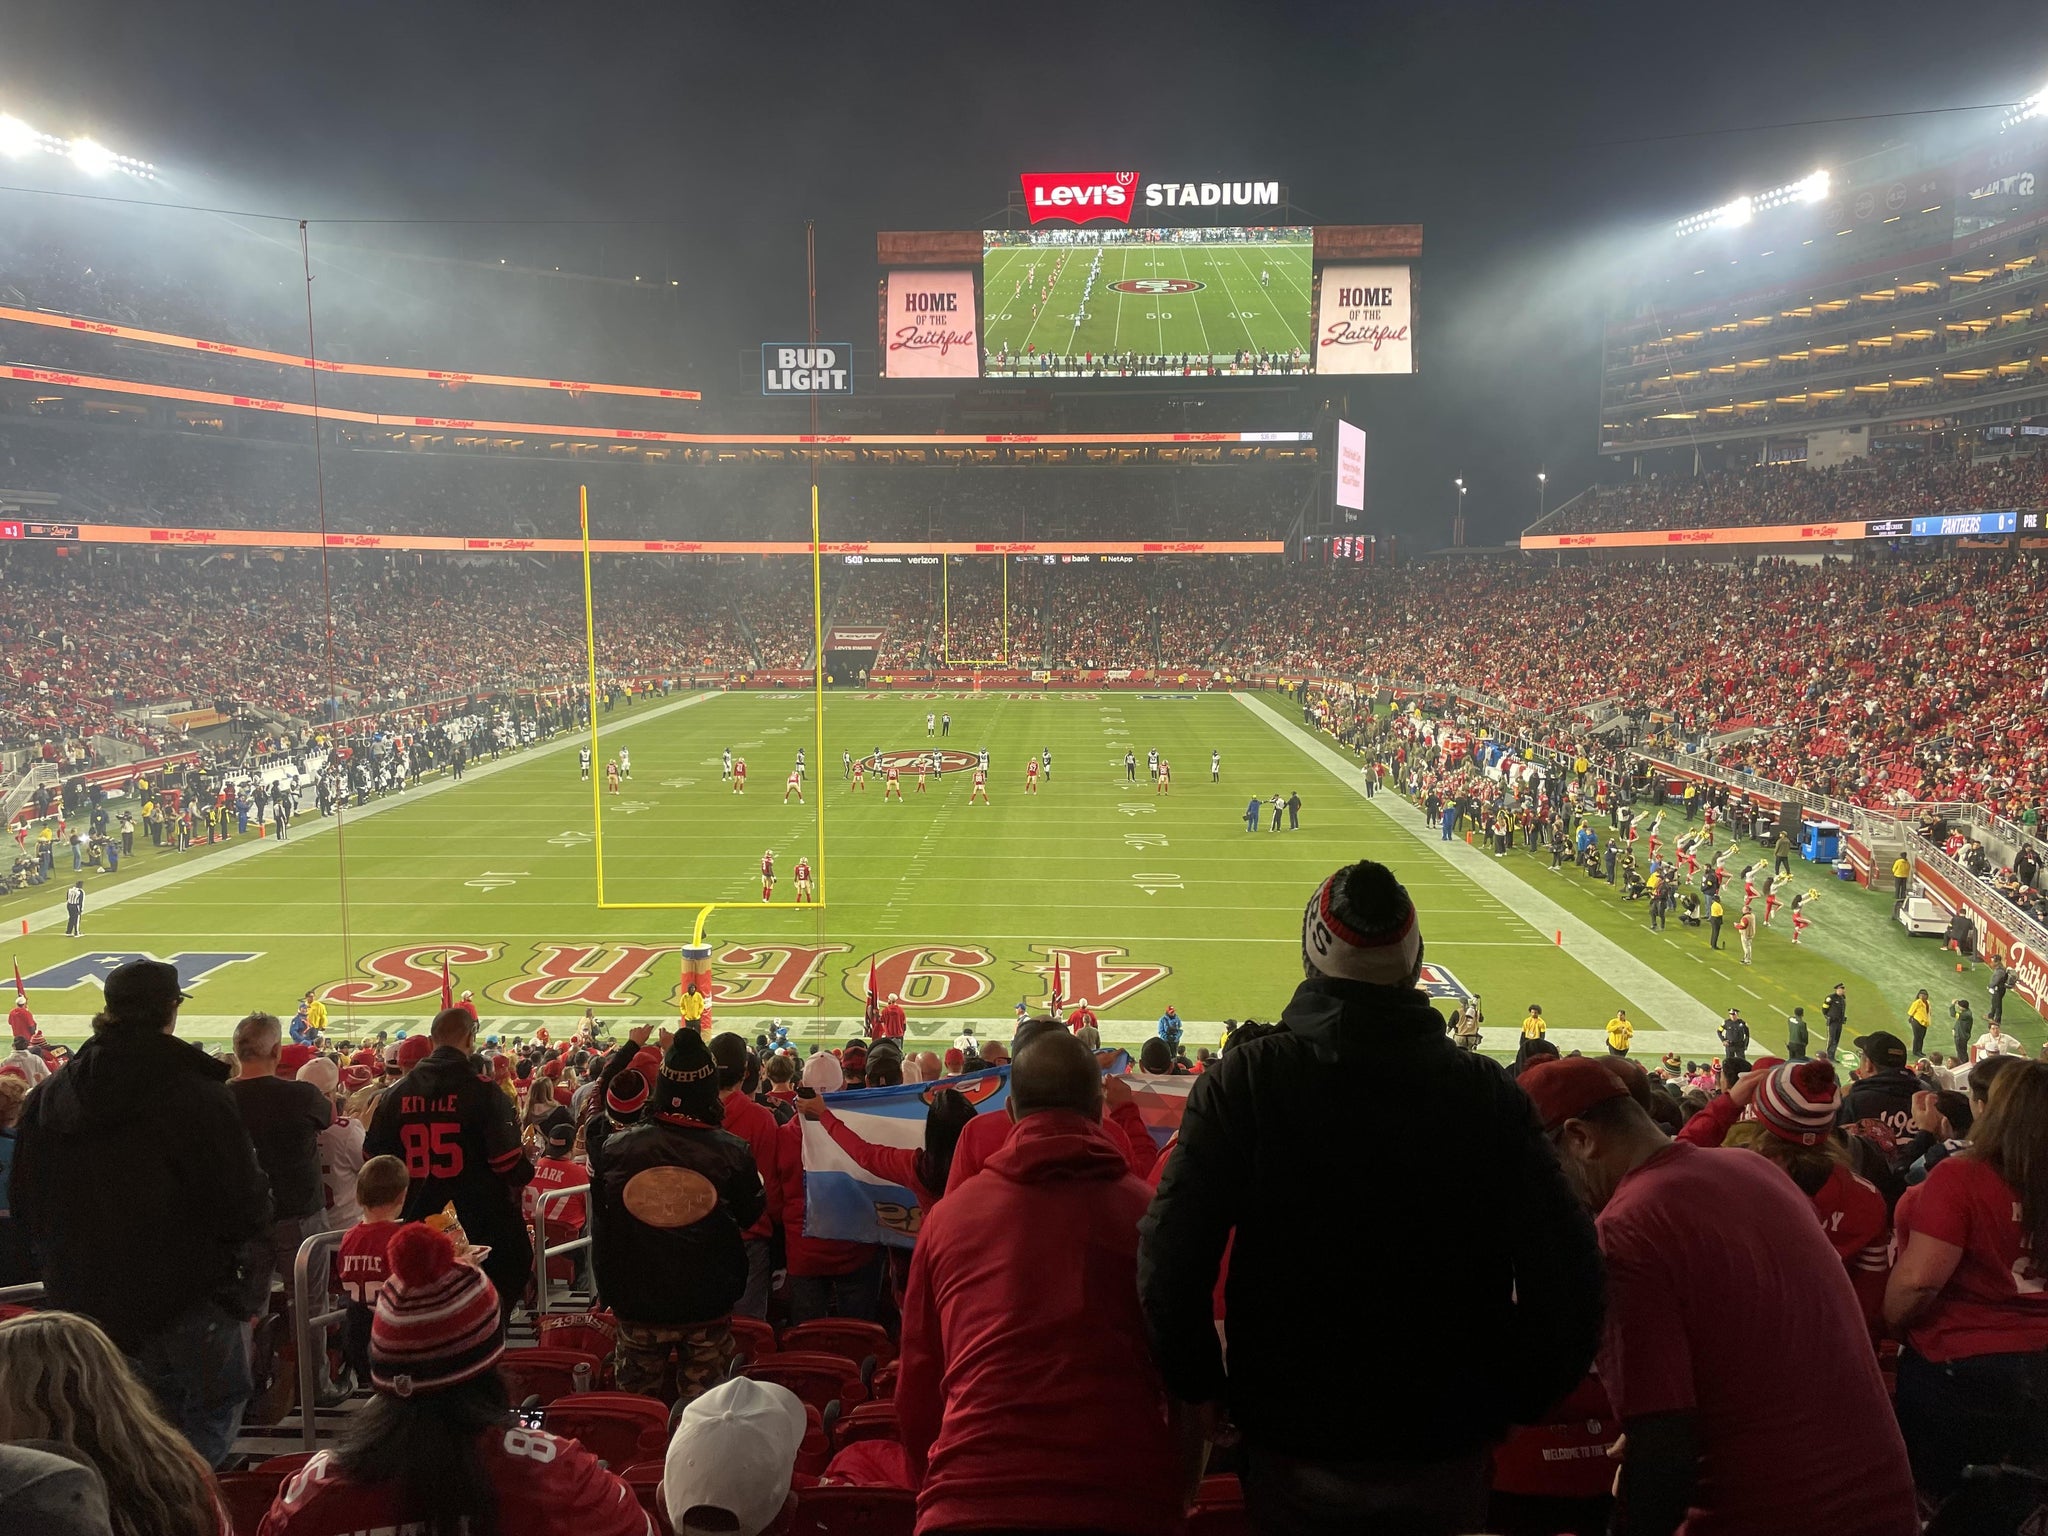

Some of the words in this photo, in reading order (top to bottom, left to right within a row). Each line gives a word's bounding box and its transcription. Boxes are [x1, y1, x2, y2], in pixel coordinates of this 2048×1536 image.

[1145, 182, 1279, 207] STADIUM
[905, 293, 957, 312] HOME
[1338, 287, 1392, 307] HOME
[916, 315, 927, 326] OF
[929, 315, 947, 326] THE
[1145, 312, 1173, 320] 50
[1349, 309, 1360, 320] OF
[1363, 309, 1381, 320] THE
[889, 326, 974, 356] Faithful
[1320, 321, 1408, 351] Faithful
[778, 348, 836, 369] BUD
[1940, 516, 1982, 534] PANTHERS
[1998, 515, 2005, 531] 0
[2023, 514, 2038, 527] PRE
[907, 555, 939, 564] verizon
[1072, 555, 1090, 563] bank
[312, 941, 1173, 1010] 49ERS
[2007, 941, 2048, 1012] Faithfu
[400, 1122, 464, 1179] 85
[534, 1166, 565, 1183] LARK
